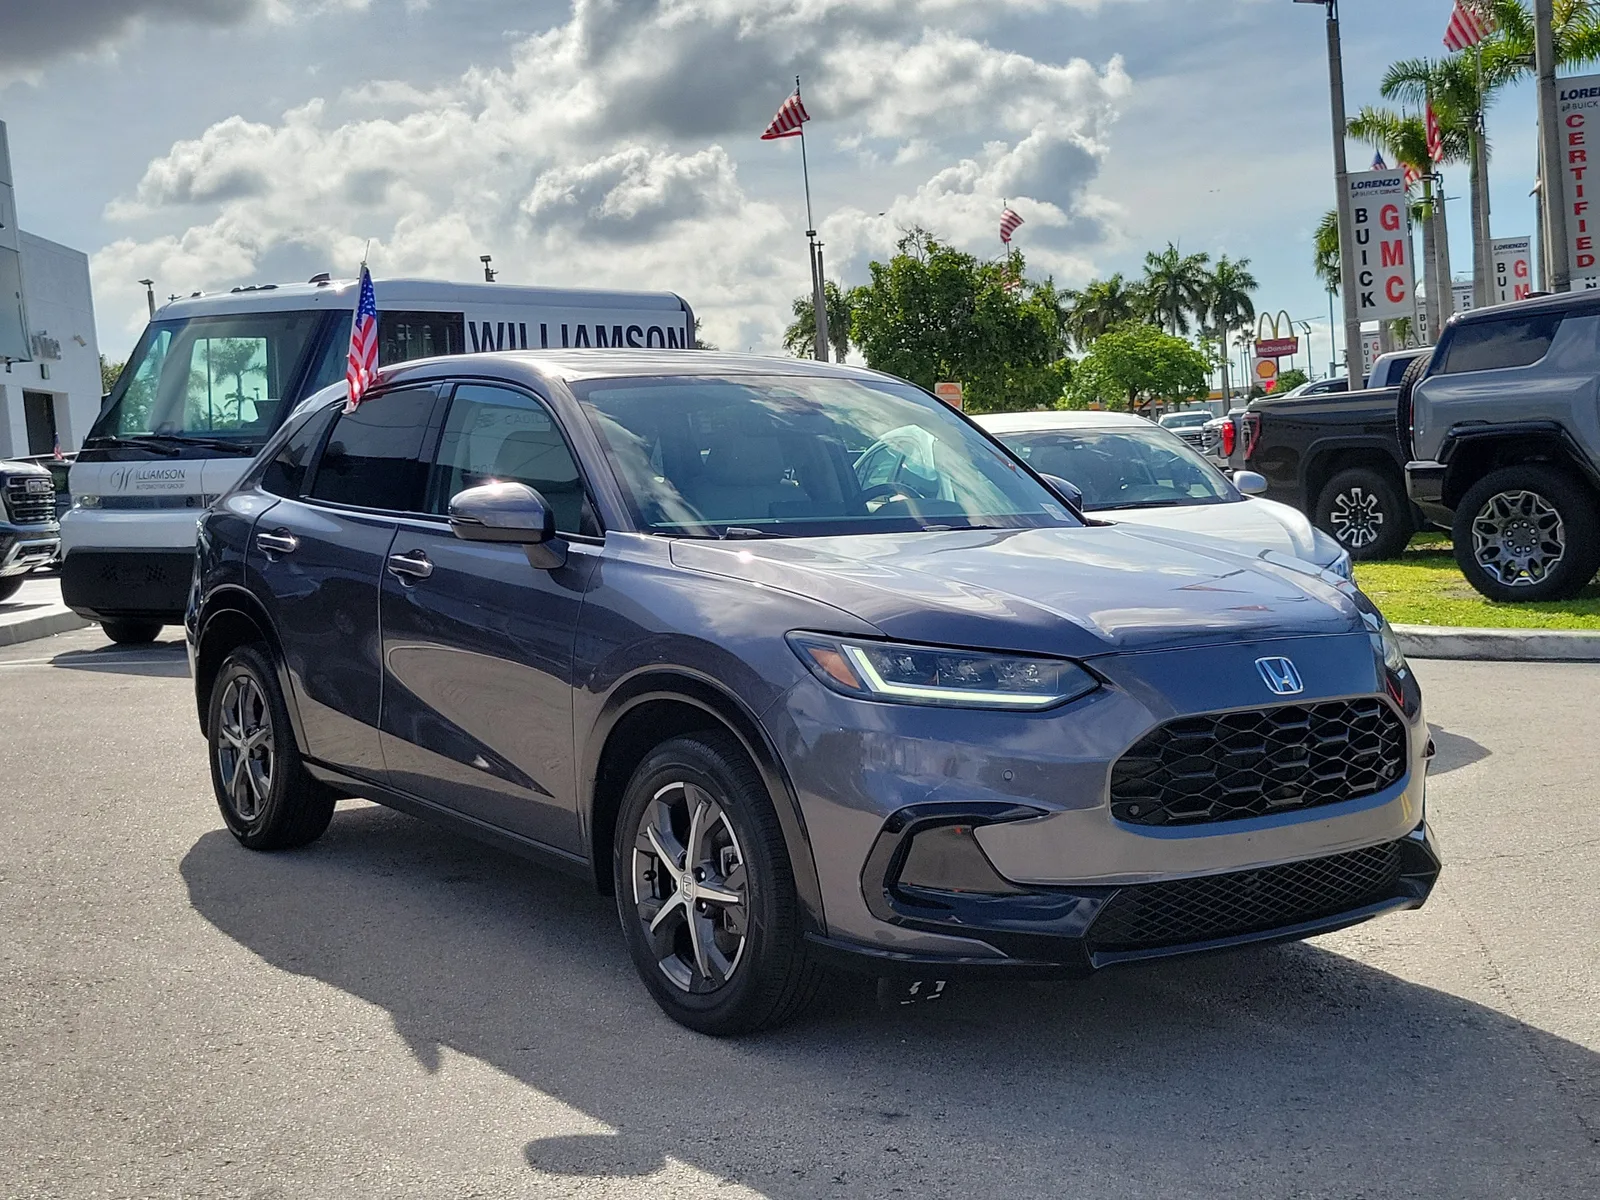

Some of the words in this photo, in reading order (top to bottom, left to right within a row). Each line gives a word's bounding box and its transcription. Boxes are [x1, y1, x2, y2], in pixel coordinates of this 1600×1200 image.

[1560, 87, 1600, 101] LORE
[1572, 101, 1598, 110] BUICK
[1351, 179, 1400, 190] LORENZO
[1565, 114, 1595, 268] CERTIFIED
[1355, 207, 1376, 308] BUICK
[1380, 204, 1404, 303] GMC
[468, 321, 685, 352] WILLIAMSON
[1257, 345, 1296, 353] McDonald's
